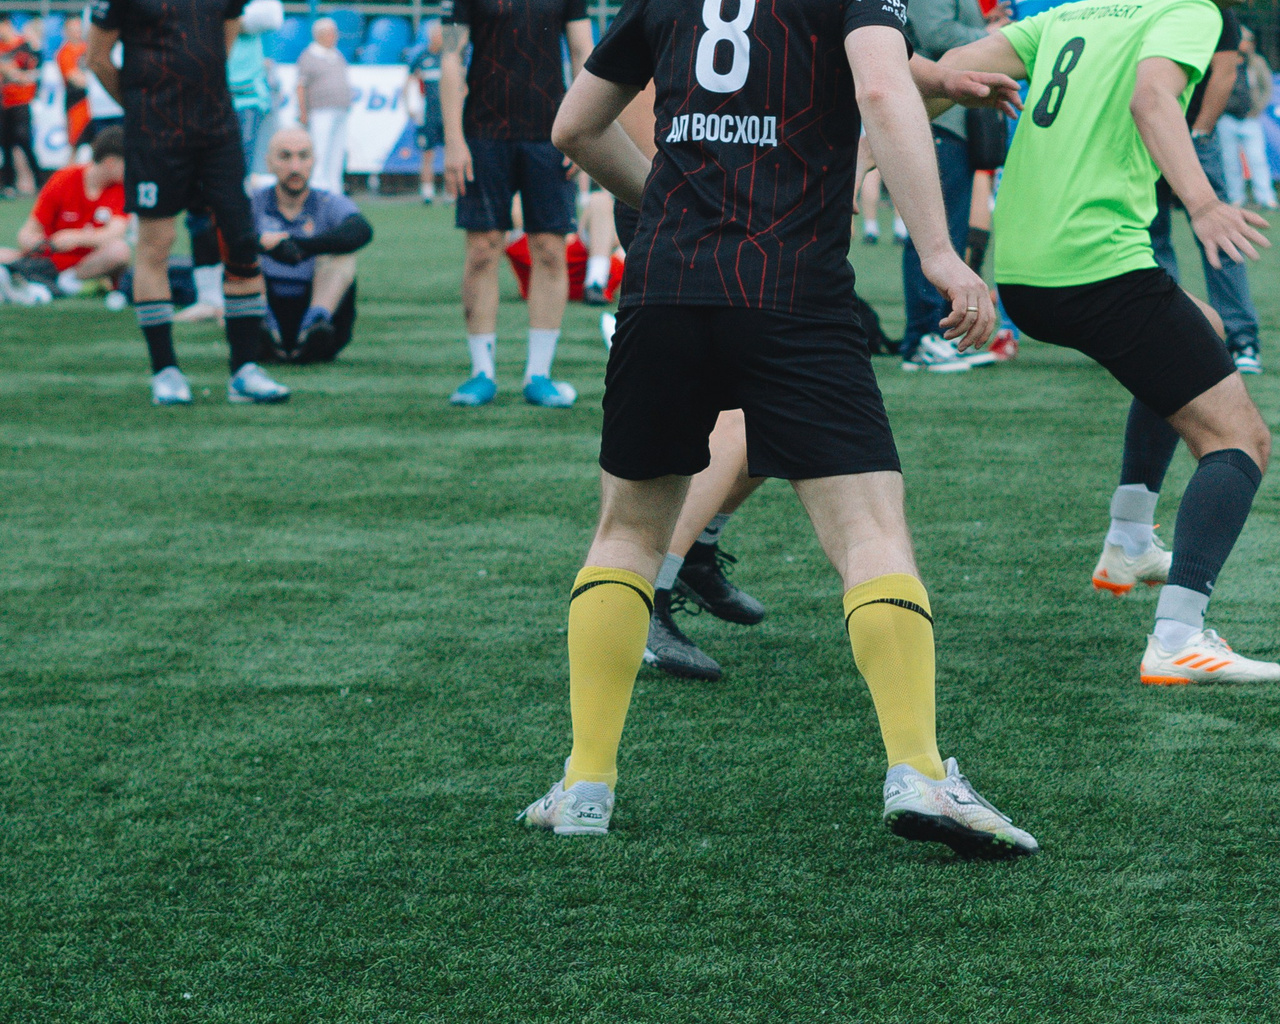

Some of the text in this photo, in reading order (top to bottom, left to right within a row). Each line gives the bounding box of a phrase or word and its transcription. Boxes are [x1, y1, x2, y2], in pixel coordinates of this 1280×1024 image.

[1032, 36, 1086, 129] 8
[666, 112, 778, 147] АП ВОСХОД
